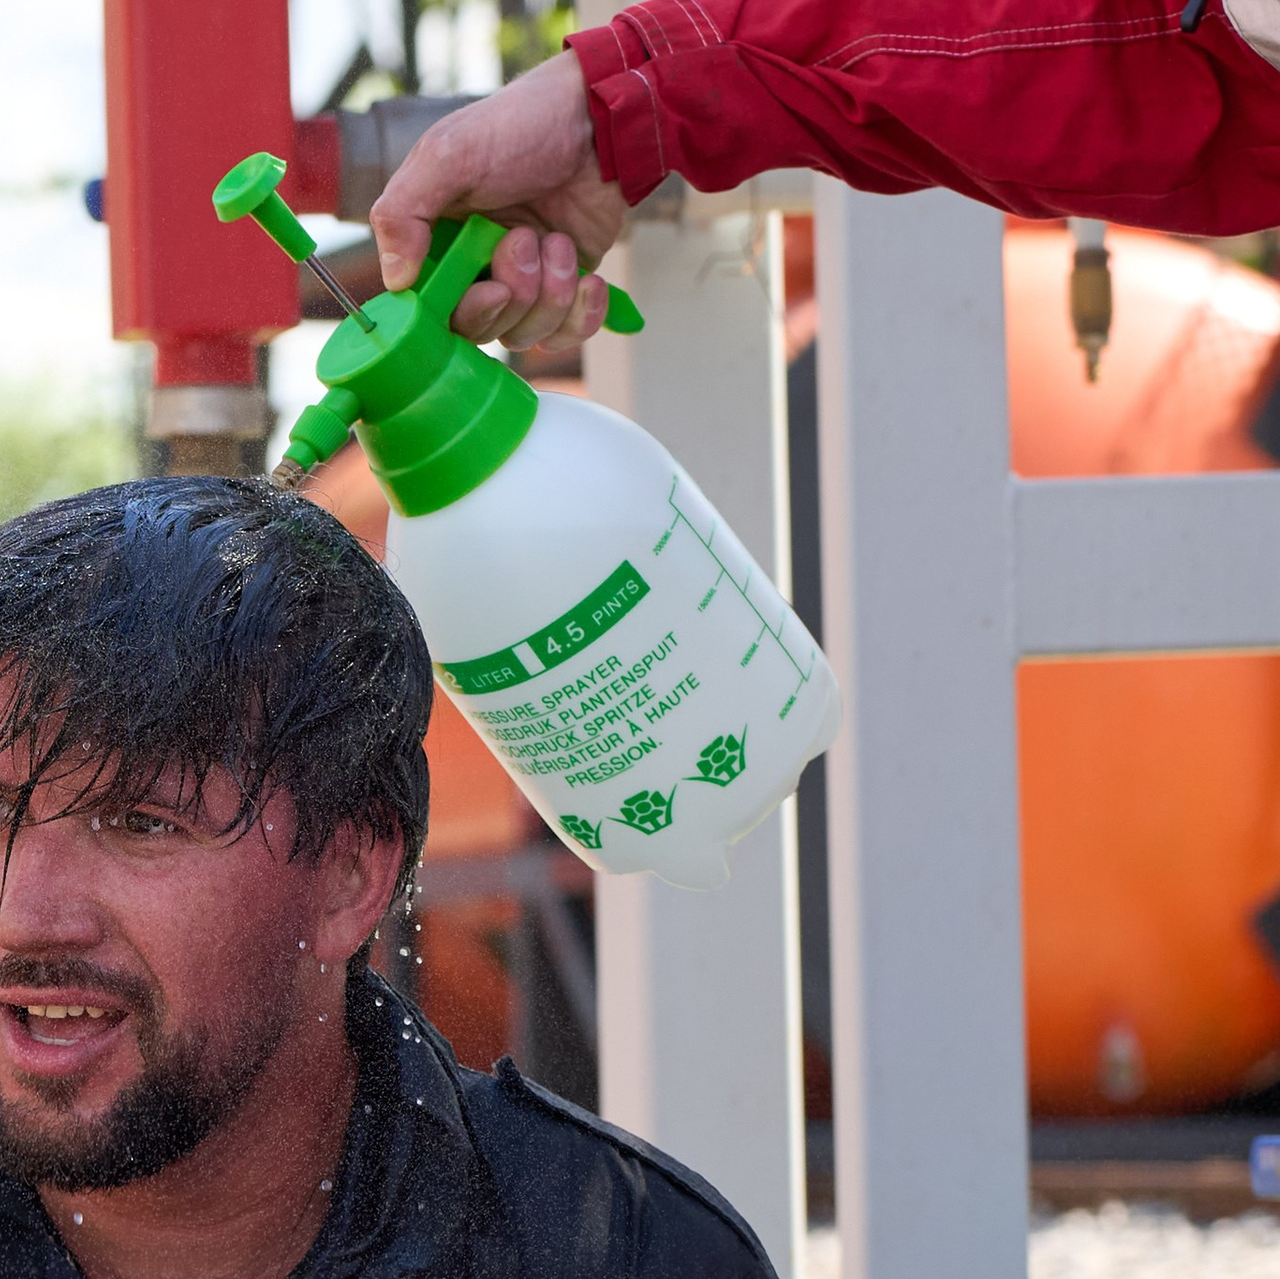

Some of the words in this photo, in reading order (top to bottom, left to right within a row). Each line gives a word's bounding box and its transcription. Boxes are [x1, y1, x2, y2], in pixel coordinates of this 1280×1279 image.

[470, 667, 516, 687] LITER
[546, 621, 585, 655] 4.5
[591, 579, 639, 625] PINTS
[483, 718, 557, 741] OGEDRUK
[558, 631, 678, 725] PLANTENSPUIT
[541, 655, 623, 710] SPRAYER
[625, 719, 643, 737] À
[644, 672, 700, 725] HAUTE
[498, 730, 581, 759] OCHDRUCK
[583, 683, 656, 738] SPRITZE
[565, 736, 663, 789] PRESSION.
